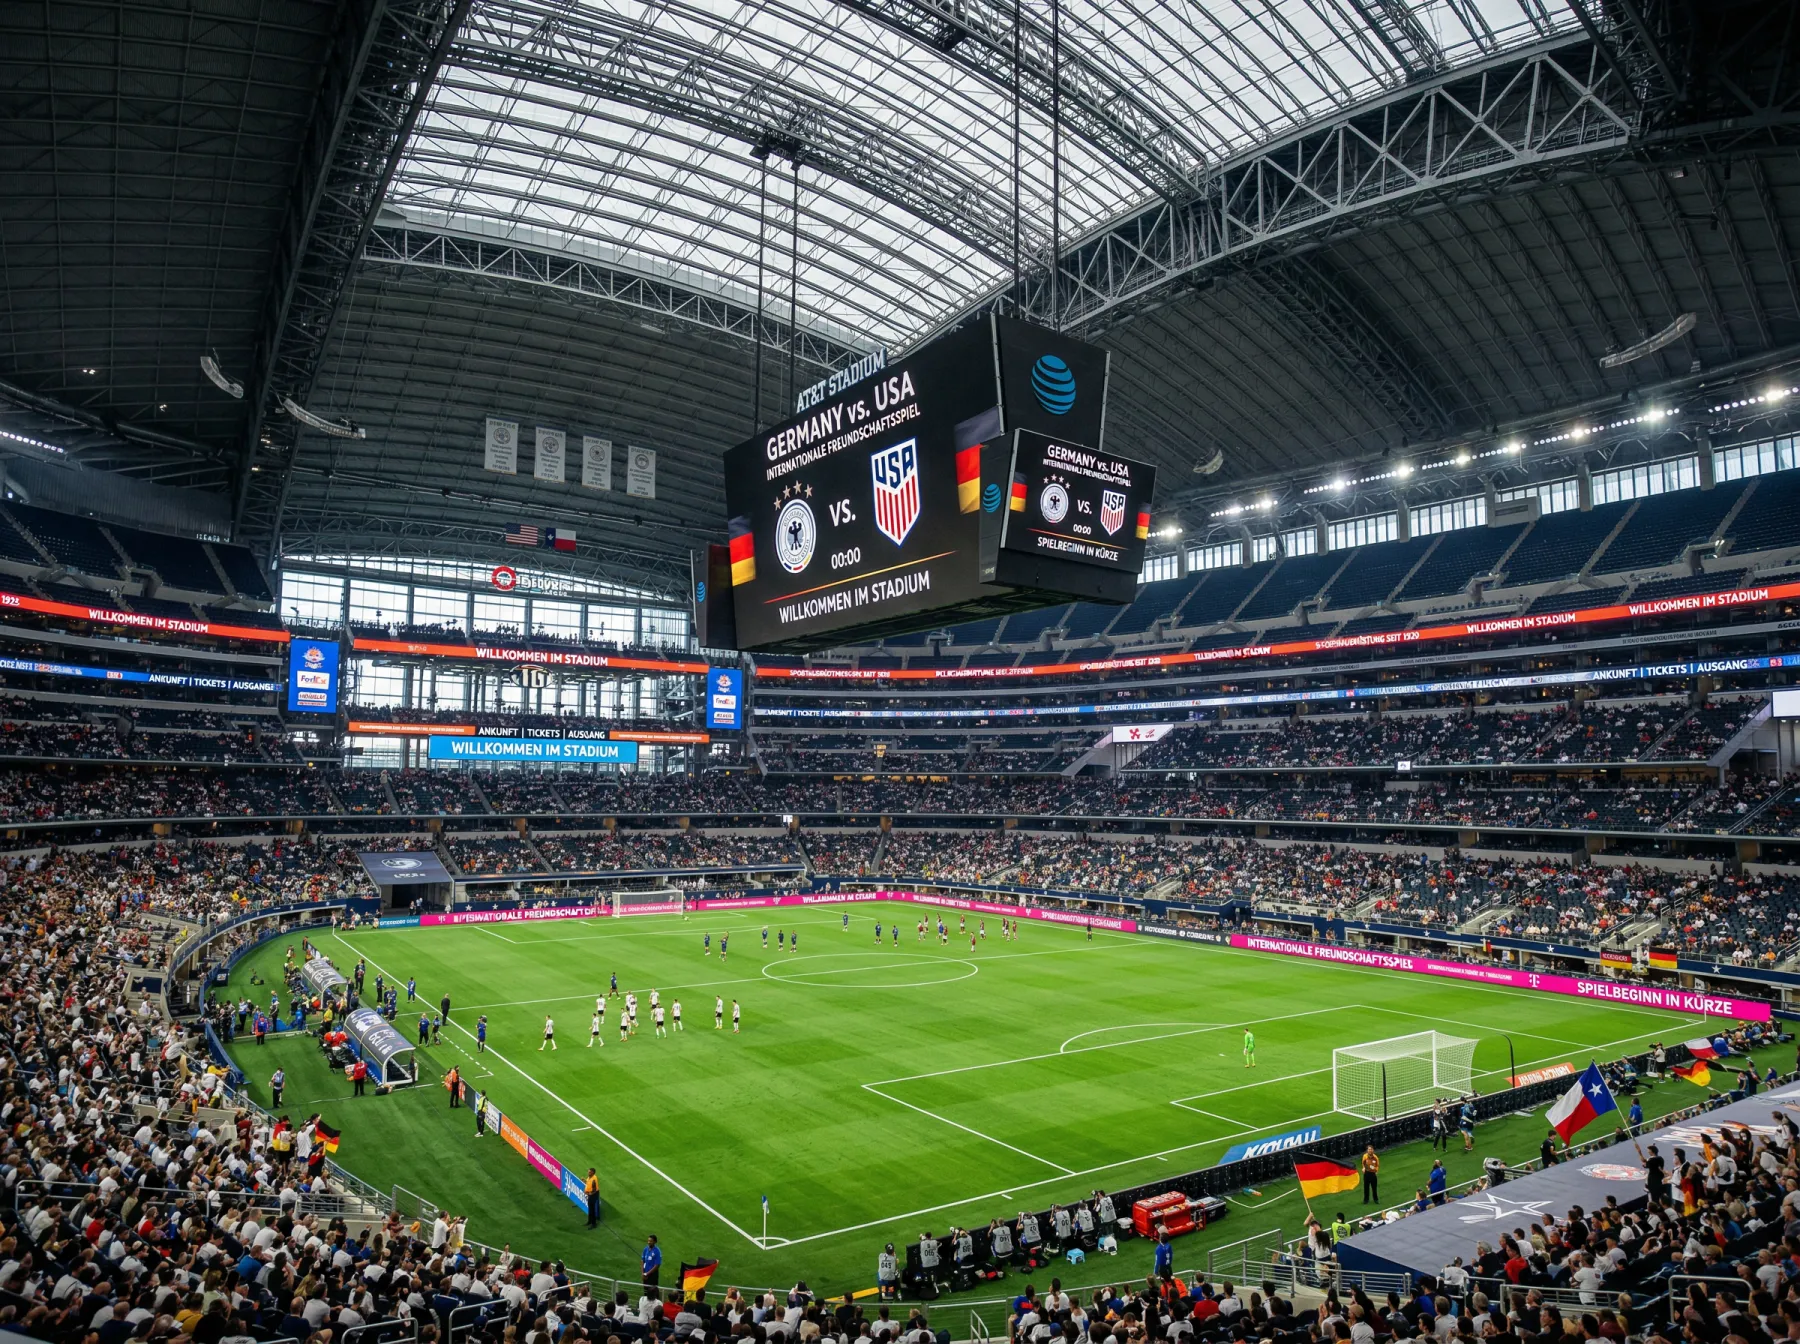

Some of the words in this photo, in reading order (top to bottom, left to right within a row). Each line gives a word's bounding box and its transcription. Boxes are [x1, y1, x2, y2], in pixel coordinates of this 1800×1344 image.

[796, 380, 826, 413] AT&T
[829, 348, 886, 396] STADIUM
[766, 403, 843, 461] GERMANY
[874, 371, 915, 411] USA
[766, 444, 827, 481] INTERNATIONALE
[827, 403, 921, 454] FREUNDSCHAFTSSPIEL
[874, 442, 914, 489] USA
[1047, 444, 1096, 468] GERMANY
[1111, 461, 1129, 478] USA
[829, 499, 856, 527] VS.
[1077, 500, 1092, 515] VS.
[831, 547, 861, 569] 00:00
[1086, 545, 1094, 556] IN
[779, 590, 851, 624] WILLKOMMEN
[855, 586, 868, 606] IM
[872, 570, 930, 602] STADIUM
[1629, 598, 1700, 615] WILLKOMMEN
[1703, 597, 1716, 607] IM
[1718, 589, 1769, 605] STADIUM
[88, 609, 153, 626] WILLKOMMEN
[155, 618, 166, 628] IM
[168, 620, 208, 633] STADIUM
[1535, 613, 1576, 626] STADIUM
[476, 647, 547, 662] WILLKOMMEN
[550, 653, 562, 663] IM
[565, 653, 608, 666] STADIUM
[149, 674, 187, 685] ANKUNFT
[194, 677, 226, 688] TICKETS
[1593, 668, 1638, 680] ANKUNFT
[1646, 665, 1687, 677] TICKETS
[1697, 660, 1748, 673] AUSGANG
[478, 727, 518, 736] ANKUNFT
[527, 728, 560, 739] TICKETS
[568, 730, 605, 739] AUSGANG
[452, 741, 542, 756] WILLKOMMEN
[546, 743, 560, 756] IM
[564, 744, 619, 758] STADIUM
[1247, 938, 1313, 956] INTERNATIONALE
[1577, 981, 1662, 1005] SPIELBEGINN
[1666, 993, 1680, 1007] IN
[1684, 995, 1733, 1015] KÜRZE
